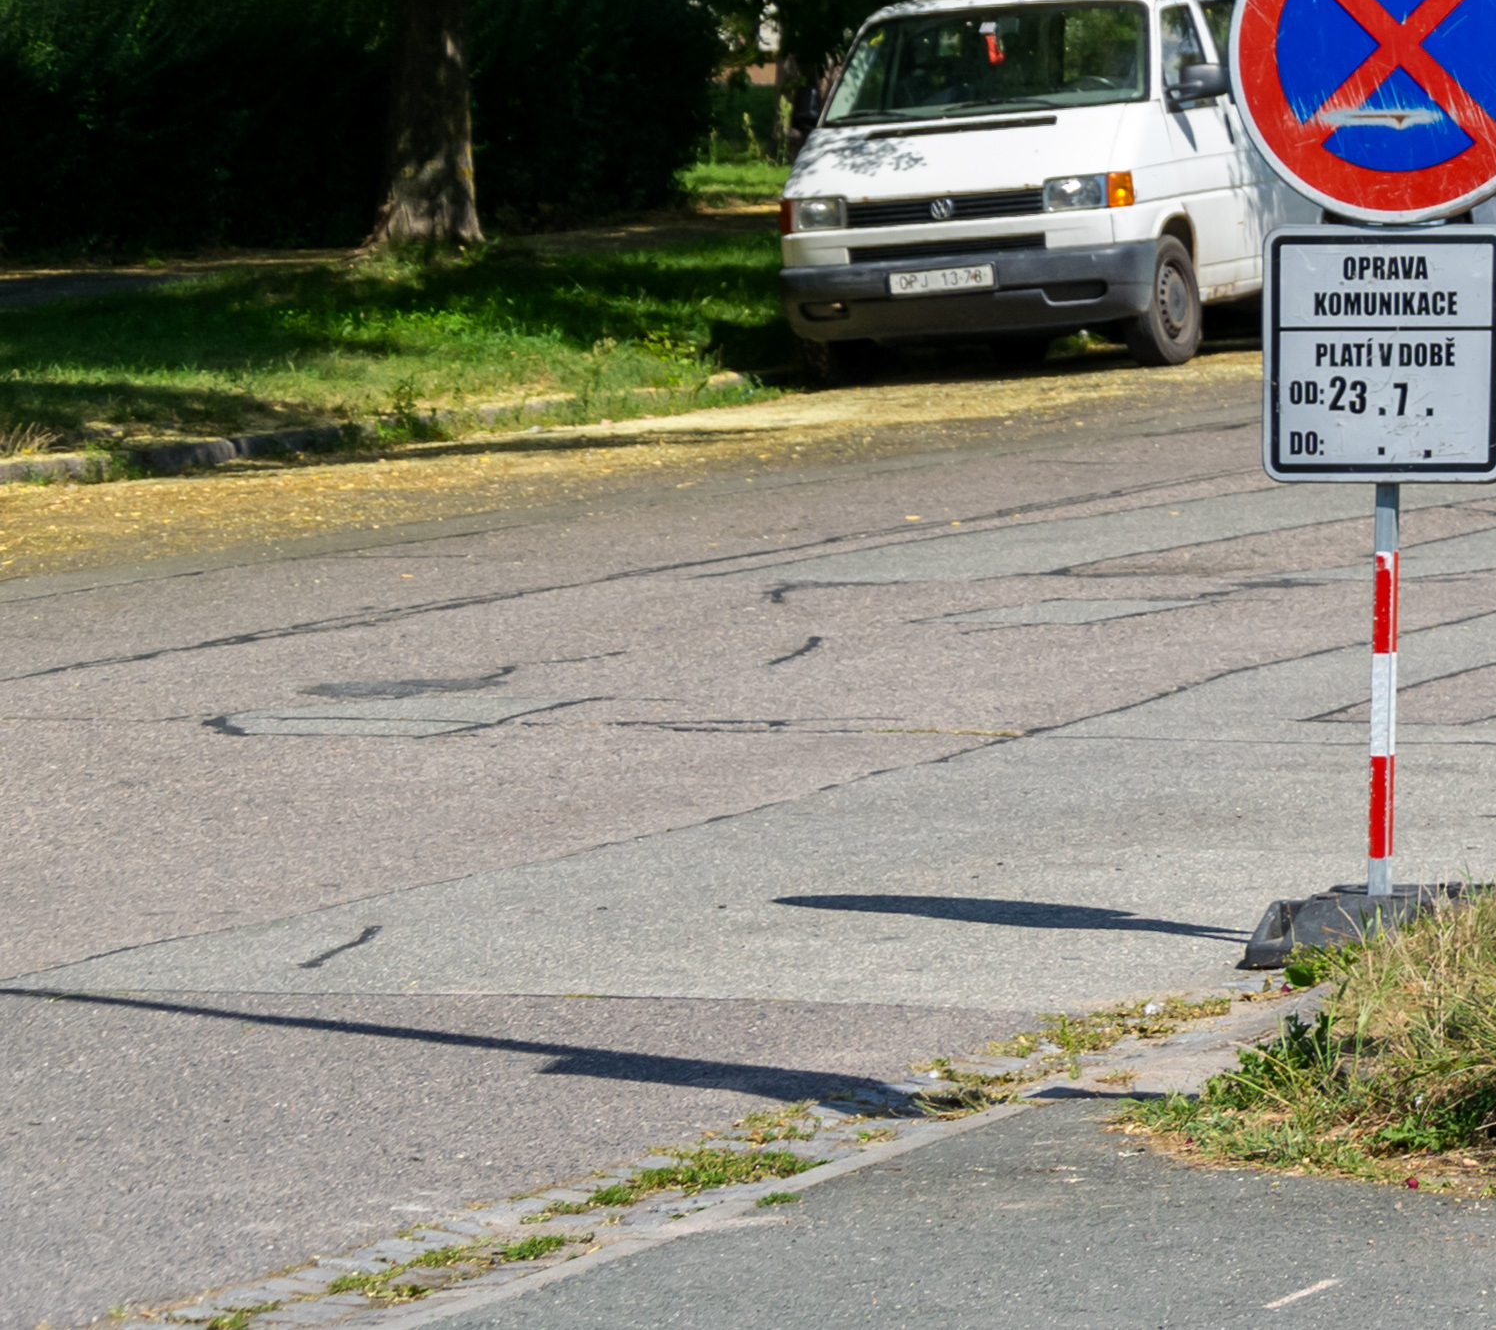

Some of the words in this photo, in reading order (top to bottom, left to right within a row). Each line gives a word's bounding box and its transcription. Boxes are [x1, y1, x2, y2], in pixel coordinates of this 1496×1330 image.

[1343, 256, 1429, 281] OPRAVA
[1314, 291, 1458, 317] KOMUNIKACE
[1315, 337, 1373, 367] PLATÍ
[1378, 342, 1394, 367] V
[1399, 337, 1456, 368] DOBĚ
[1289, 430, 1325, 456] DO:
